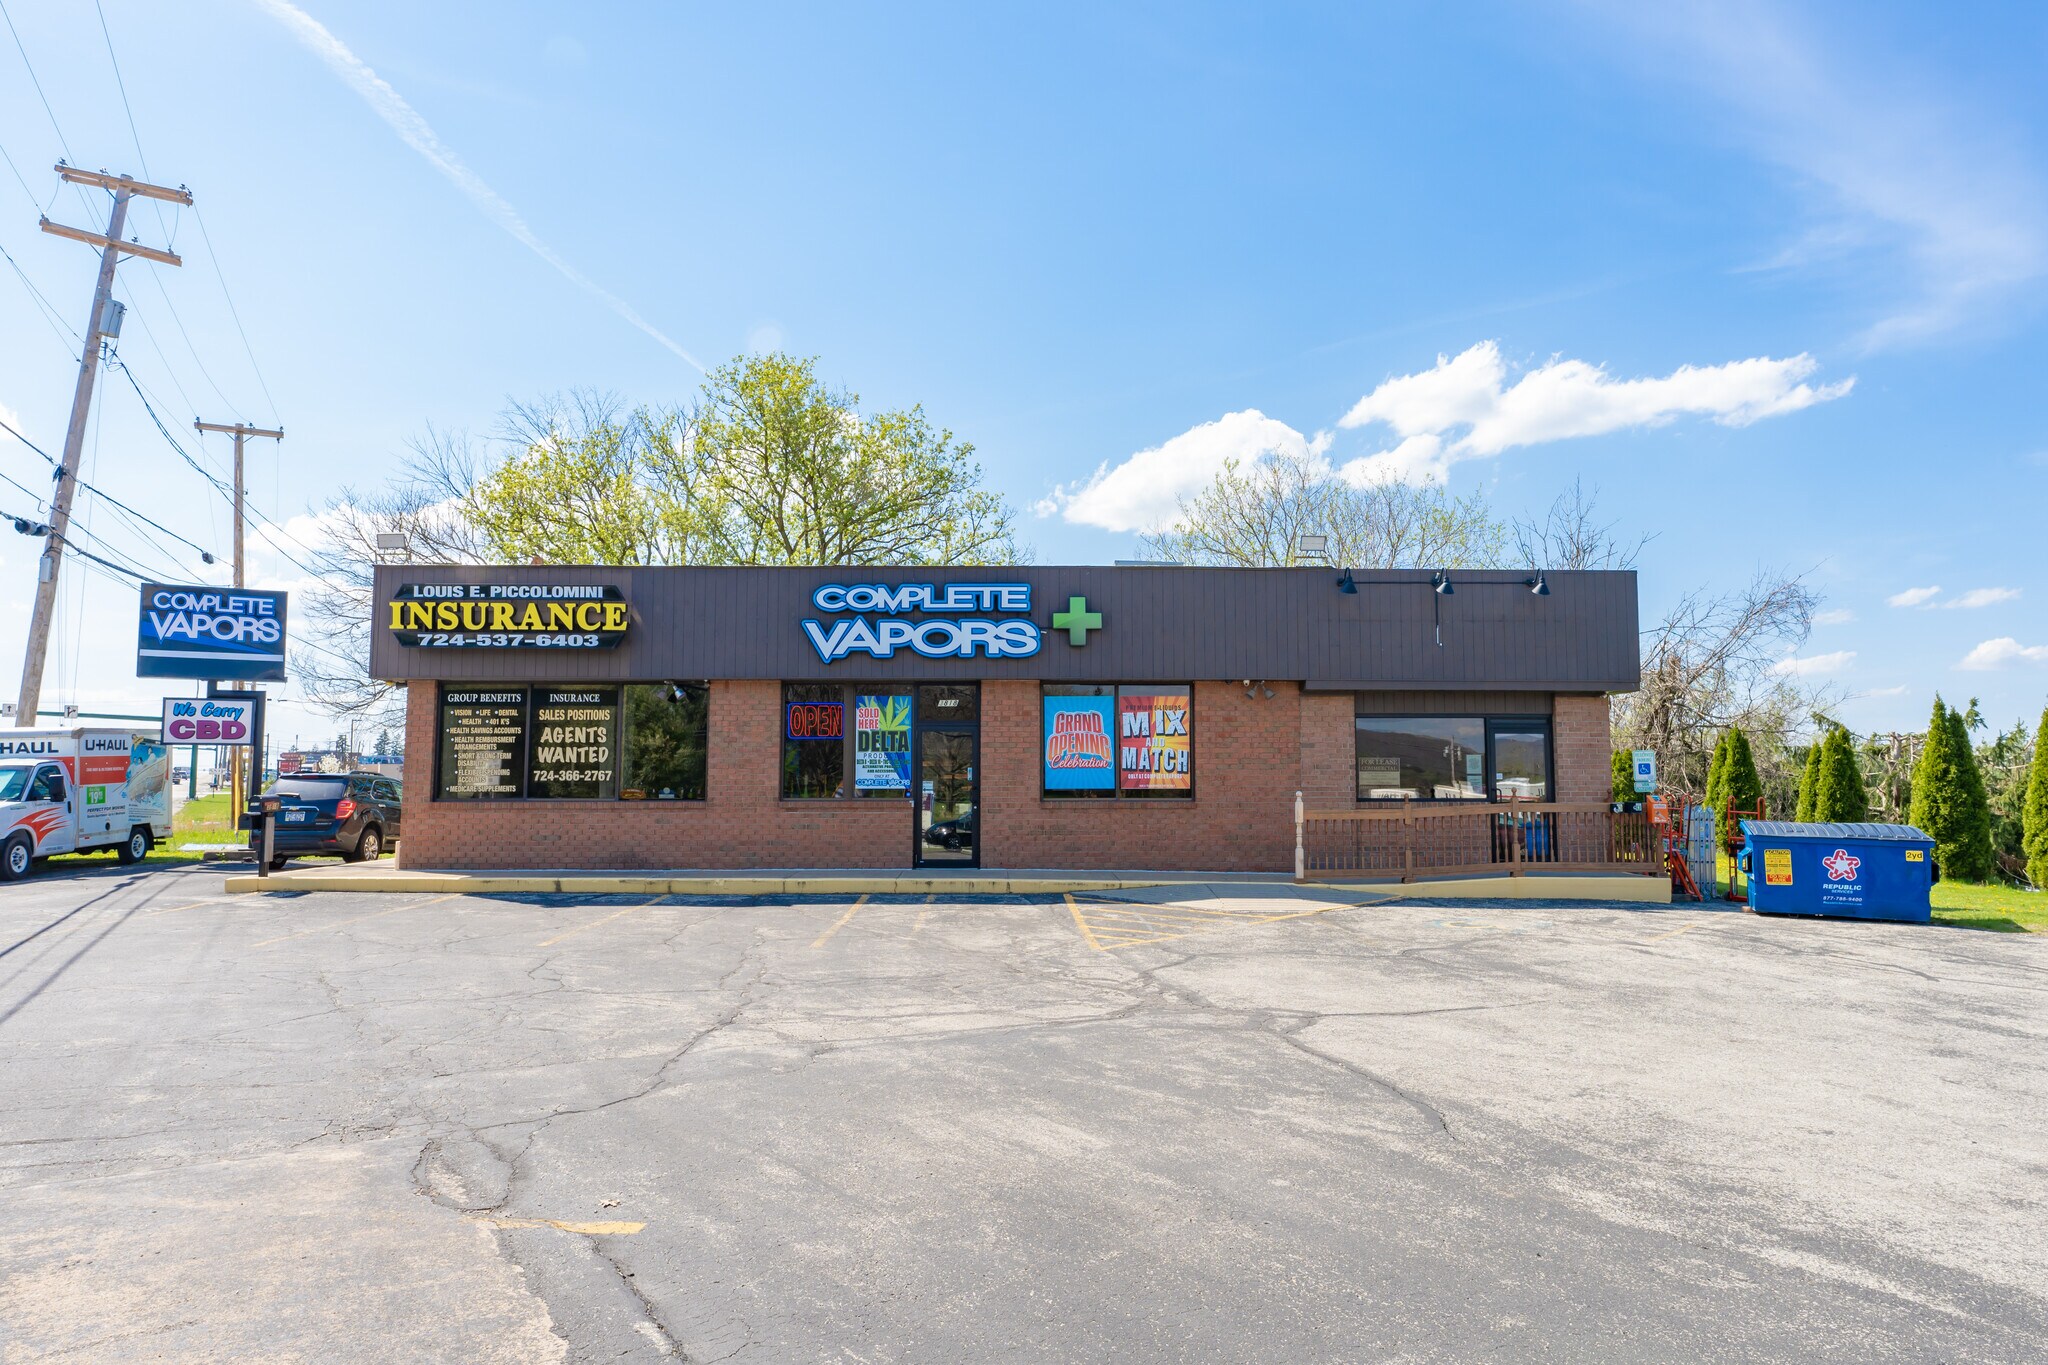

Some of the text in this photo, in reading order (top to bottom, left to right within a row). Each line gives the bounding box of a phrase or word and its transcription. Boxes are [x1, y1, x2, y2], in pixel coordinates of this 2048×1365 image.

[413, 585, 604, 599] LOUIS E. PICCOLOMINI
[814, 584, 1031, 614] COMPLETE
[152, 591, 275, 616] COMPLETE
[388, 601, 628, 631] INSURANCE
[148, 611, 281, 643] VAPORS
[417, 633, 599, 647] 724-537-6403
[802, 616, 1041, 664] VAPORS
[447, 693, 522, 703] GROUP BENEFITS
[549, 693, 601, 703] INSURANCE
[172, 702, 244, 721] We Carry
[538, 709, 611, 721] SALES POSITIONS
[858, 707, 879, 718] SOLD
[169, 719, 247, 740] CBD
[789, 705, 844, 737] OPEN
[858, 719, 879, 729] HERE
[1055, 711, 1103, 734] GRAND
[1121, 710, 1188, 738] MIX
[539, 726, 607, 744] AGENTS
[857, 730, 910, 752] DELTA
[1145, 738, 1166, 747] AND
[85, 739, 129, 751] U-HAUL
[1047, 732, 1112, 762] OPENING
[537, 746, 610, 764] WANTED
[1051, 754, 1109, 769] Celebration
[1121, 747, 1189, 774] MATCH
[533, 770, 613, 782] 724-366-2767
[856, 778, 911, 788] COMPLETE VAPORS
[1906, 851, 1923, 860] 2yd
[1822, 883, 1862, 891] REPUBLIC
